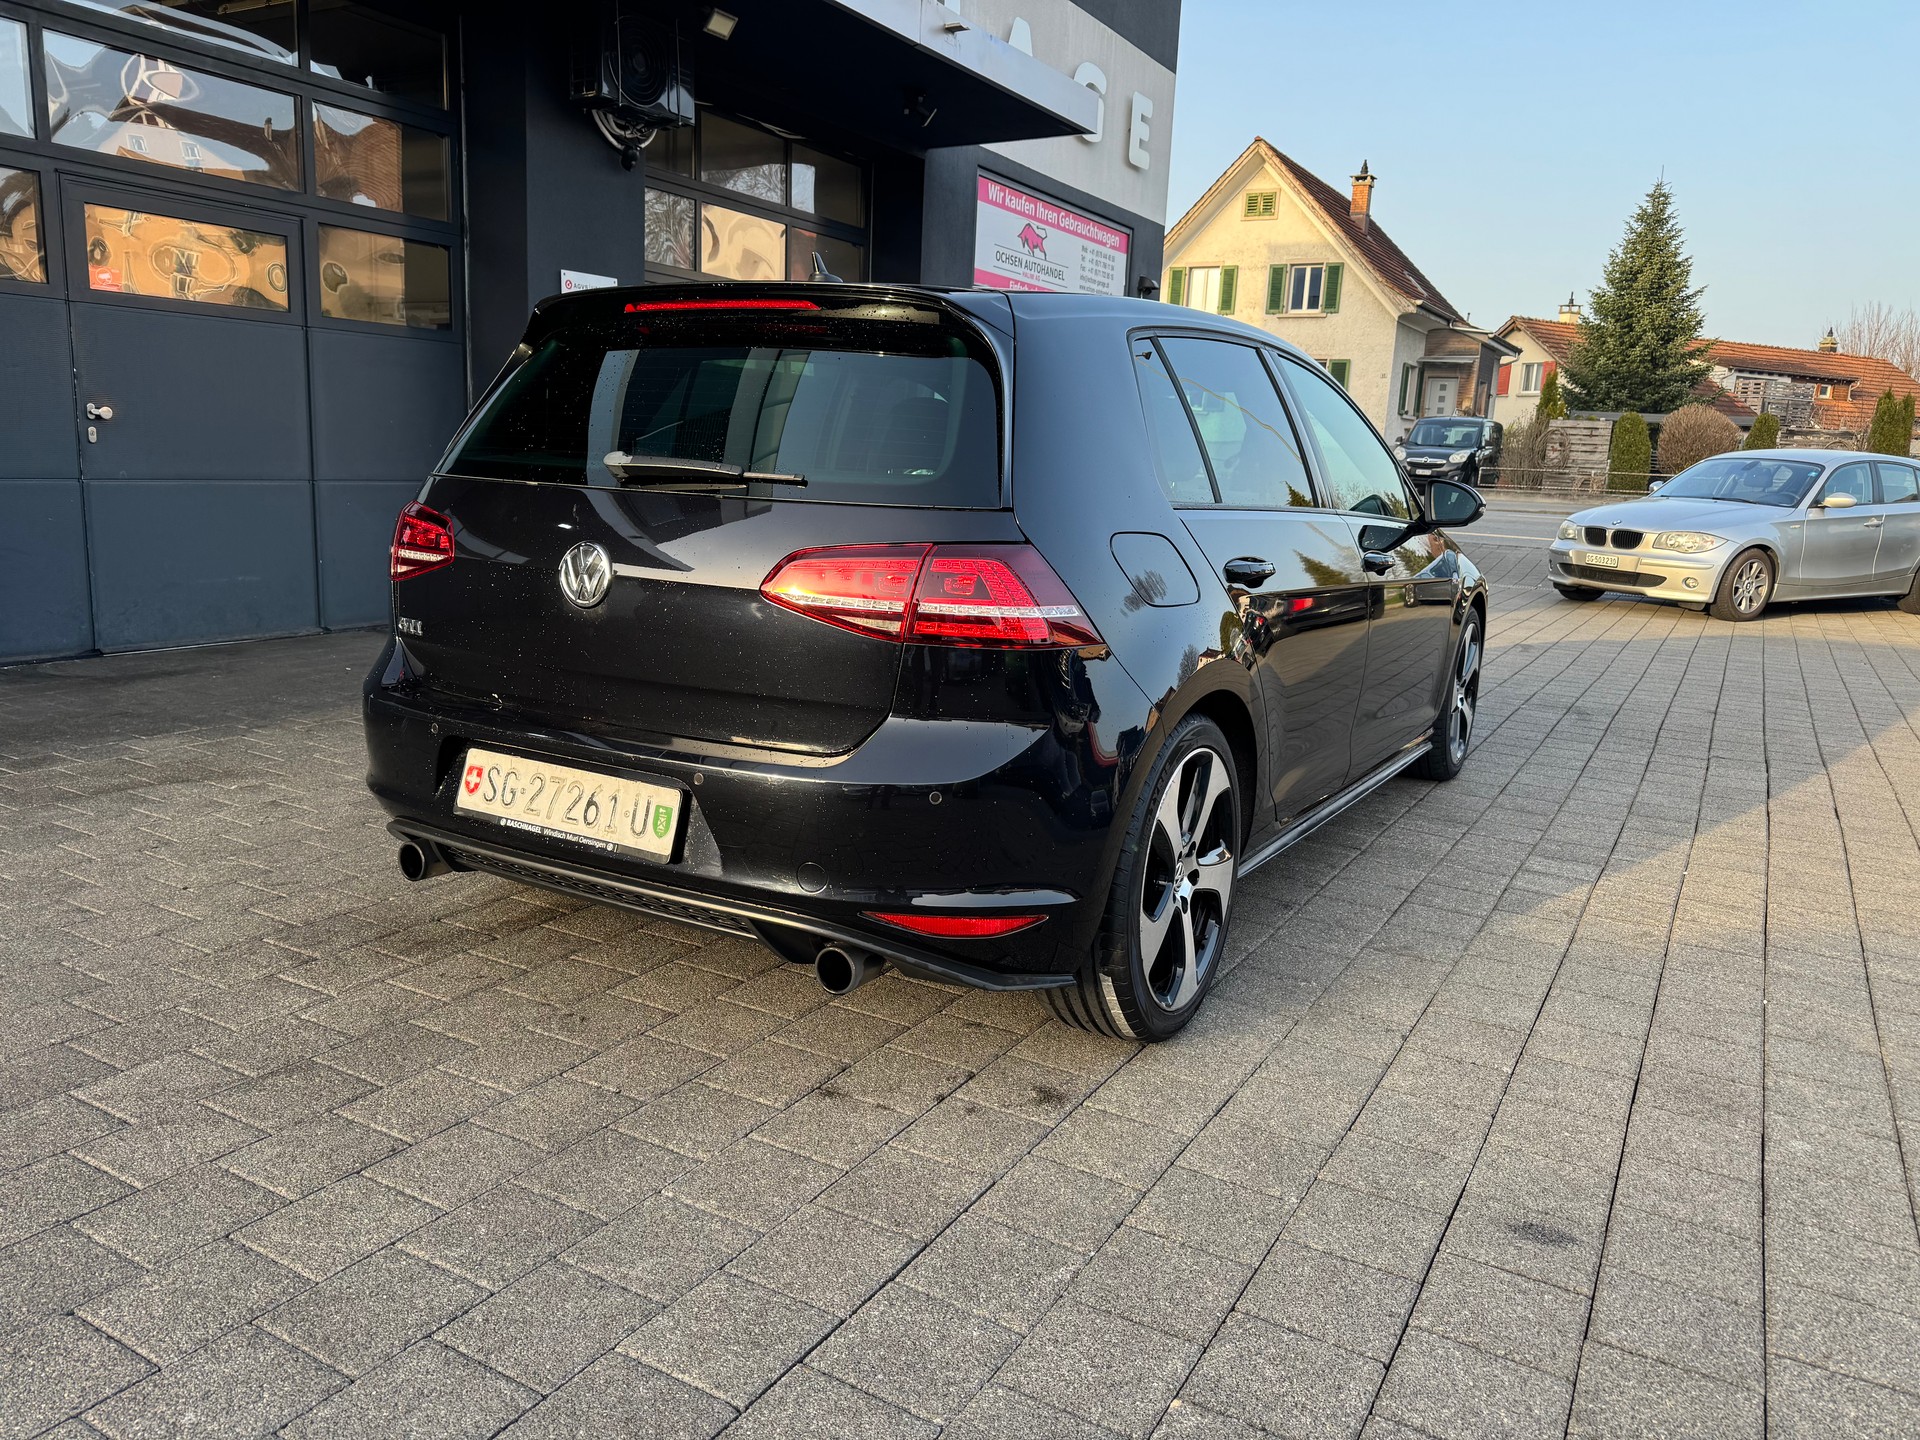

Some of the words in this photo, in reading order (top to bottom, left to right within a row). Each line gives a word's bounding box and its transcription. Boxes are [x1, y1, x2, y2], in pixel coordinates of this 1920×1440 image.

[988, 182, 1005, 203] Wir
[1005, 188, 1035, 217] kaufen
[1036, 203, 1058, 224] Ihren
[1059, 212, 1119, 247] Gebrauchtwagen
[995, 250, 1023, 269] OCHSEN
[1023, 258, 1065, 281] AUTOHANDEL
[506, 818, 542, 834] BASCHNAGEL
[543, 828, 567, 840] Windisch
[579, 836, 607, 849] Oensingen
